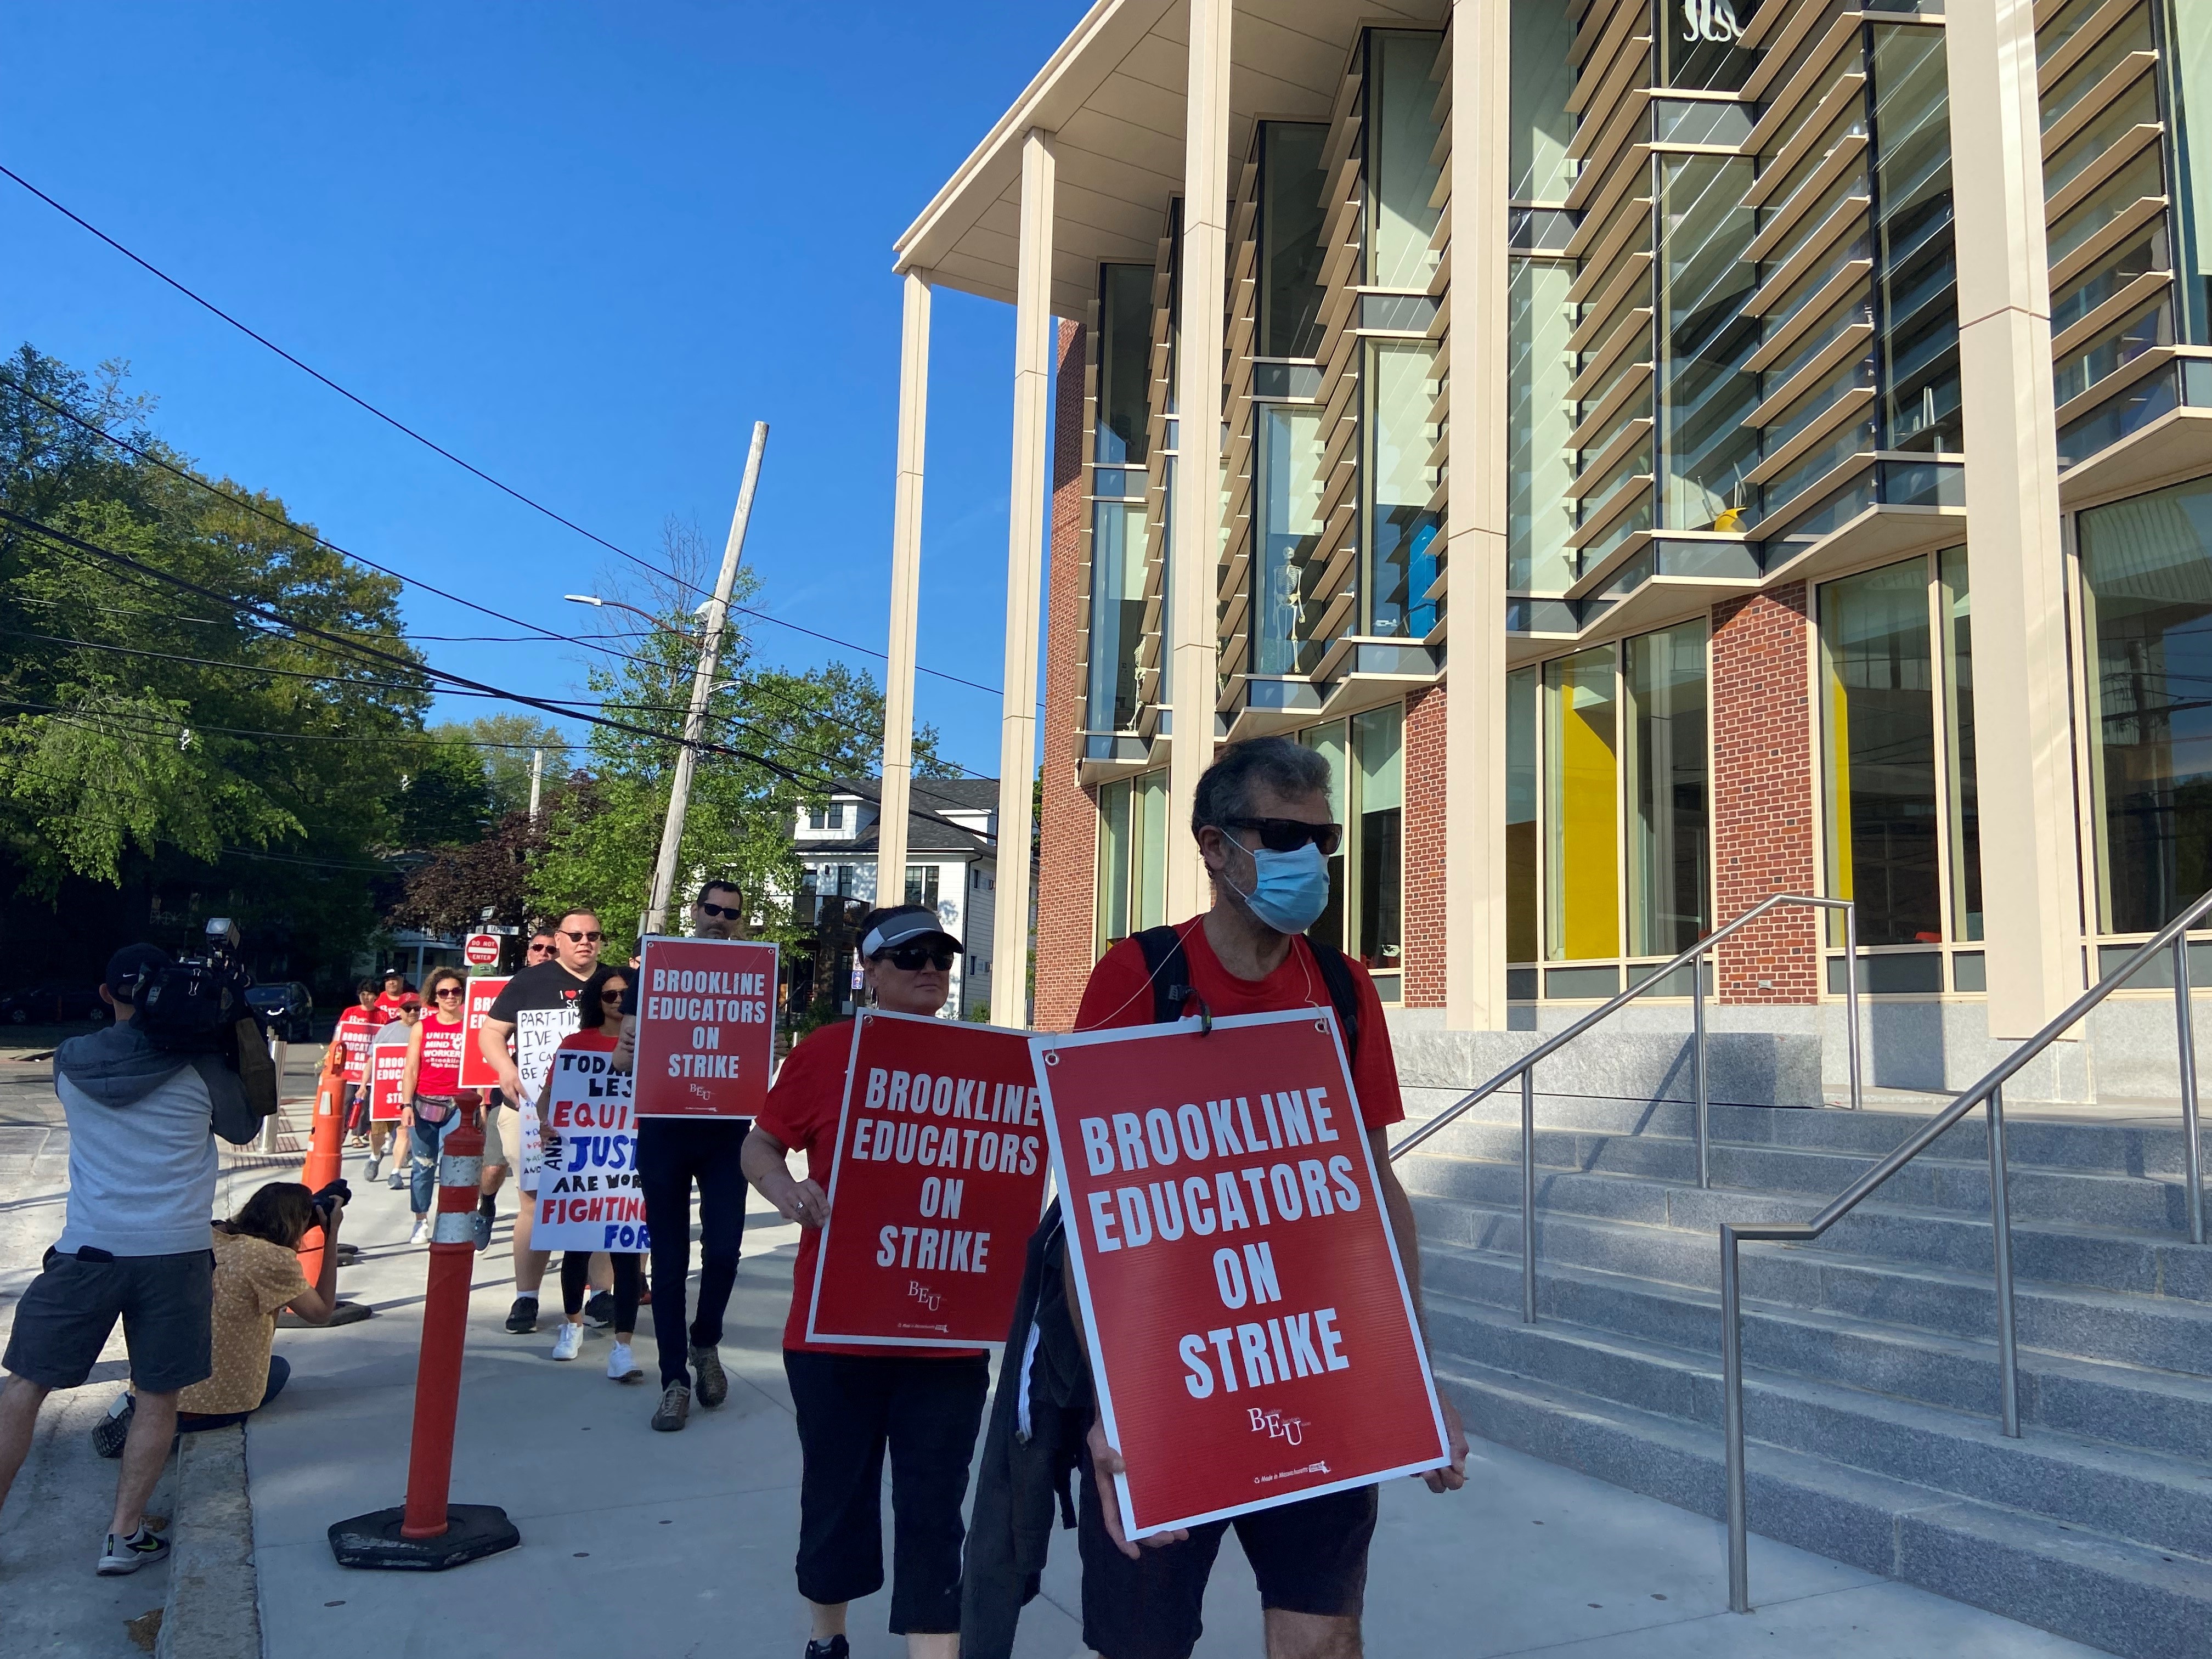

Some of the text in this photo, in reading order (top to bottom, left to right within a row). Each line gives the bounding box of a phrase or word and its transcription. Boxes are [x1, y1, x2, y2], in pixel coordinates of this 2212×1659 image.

[652, 968, 765, 996] BROOKLINE
[521, 1011, 579, 1028] PART-TIM
[647, 996, 766, 1024] EDUCATORS
[692, 1026, 720, 1049] ON
[523, 1052, 533, 1065] I
[668, 1053, 740, 1079] STRIKE
[521, 1067, 538, 1080] BE
[690, 1084, 711, 1100] BEU
[865, 1067, 1042, 1126] BROOKLINE
[553, 1101, 638, 1130] EQUI
[1080, 1086, 1339, 1176] BROOKLINE
[851, 1118, 1040, 1176] EDUCATORS
[552, 1173, 642, 1194] ARE WOR
[919, 1177, 964, 1220] ON
[1088, 1155, 1361, 1253] EDUCATORS
[603, 1224, 651, 1250] FOR
[877, 1224, 991, 1273] STRIKE
[1213, 1241, 1282, 1310] ON
[907, 1280, 941, 1311] BEU
[1178, 1307, 1350, 1400] STRIKE
[1246, 1407, 1302, 1446] BEU
